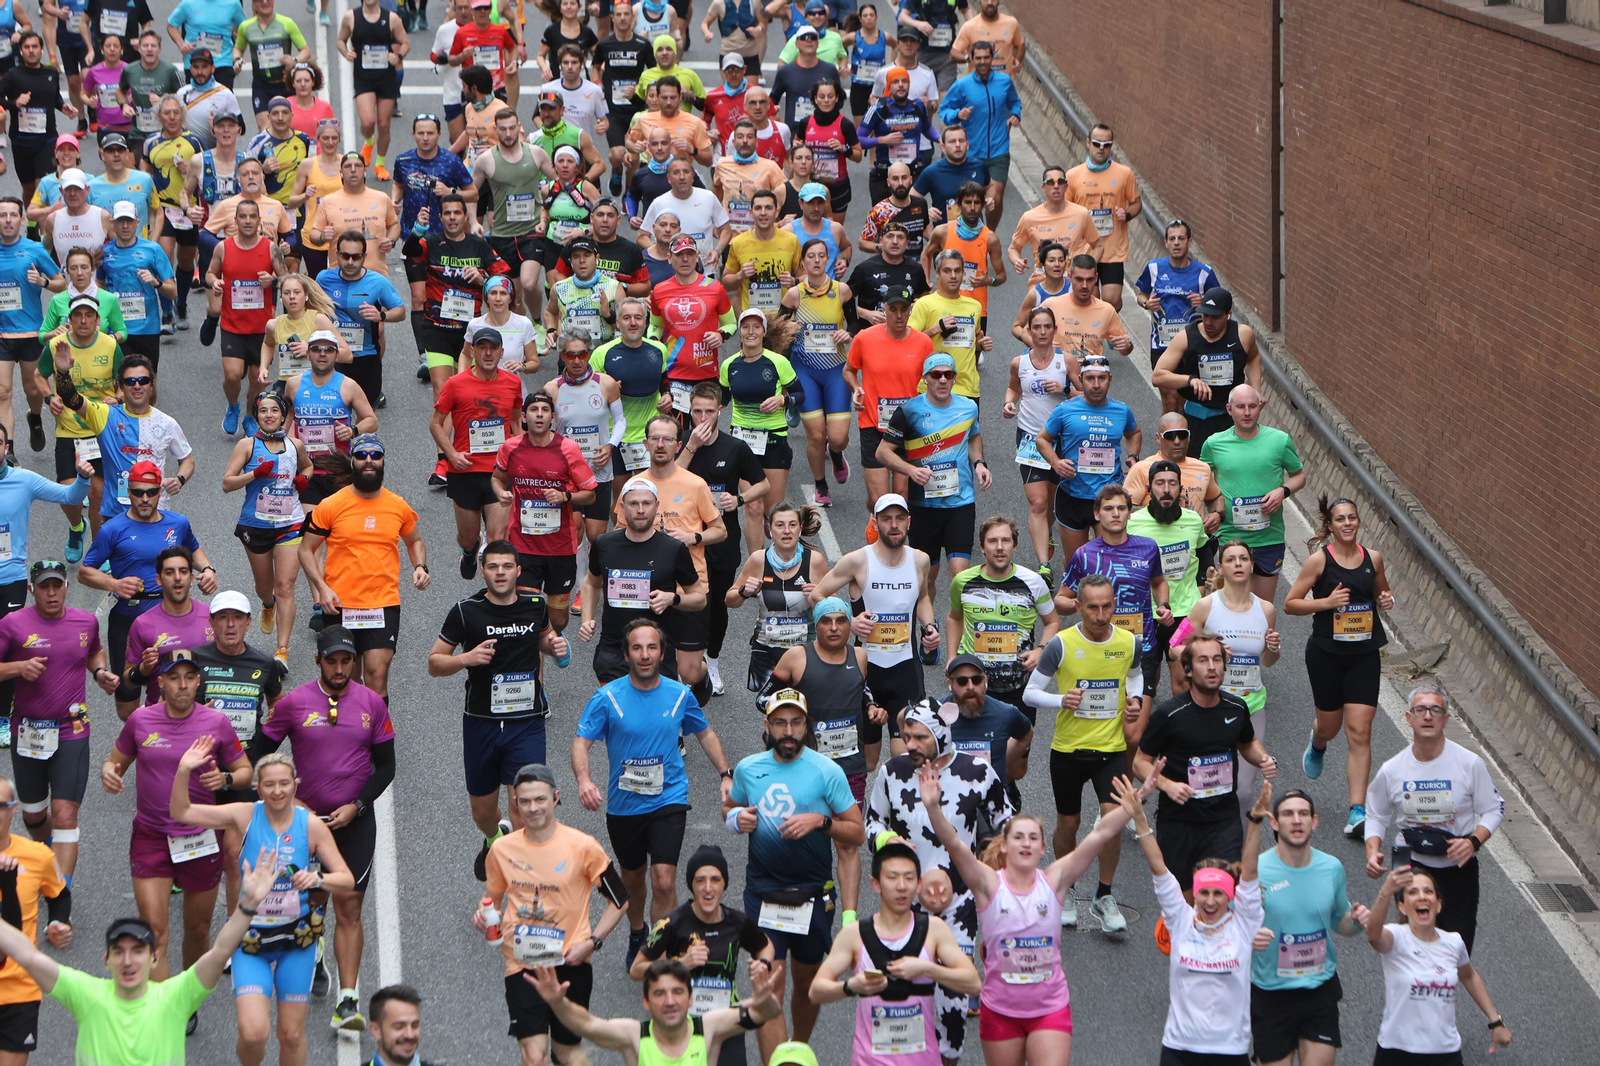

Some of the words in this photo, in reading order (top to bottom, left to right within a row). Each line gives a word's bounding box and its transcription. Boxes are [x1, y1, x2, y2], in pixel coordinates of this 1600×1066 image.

[451, 257, 482, 267] RUNNING
[455, 290, 474, 299] ZURICH
[294, 407, 345, 416] CREDUS
[922, 434, 941, 446] CLUB
[121, 444, 153, 456] barro's
[514, 476, 561, 487] CUATRECASAS
[1165, 544, 1186, 553] ZURICH
[487, 622, 534, 636] Daralux
[506, 673, 530, 681] ZURICH
[206, 683, 259, 696] BARCELONA
[829, 721, 853, 729] ZURICH
[273, 882, 292, 891] URICH
[512, 880, 535, 889] Maratón
[532, 927, 560, 938] ZURICH
[1298, 932, 1323, 942] ZURICH
[1019, 938, 1046, 947] ZURICH
[697, 978, 726, 988] ZURICH
[889, 1007, 919, 1017] ZURICH
